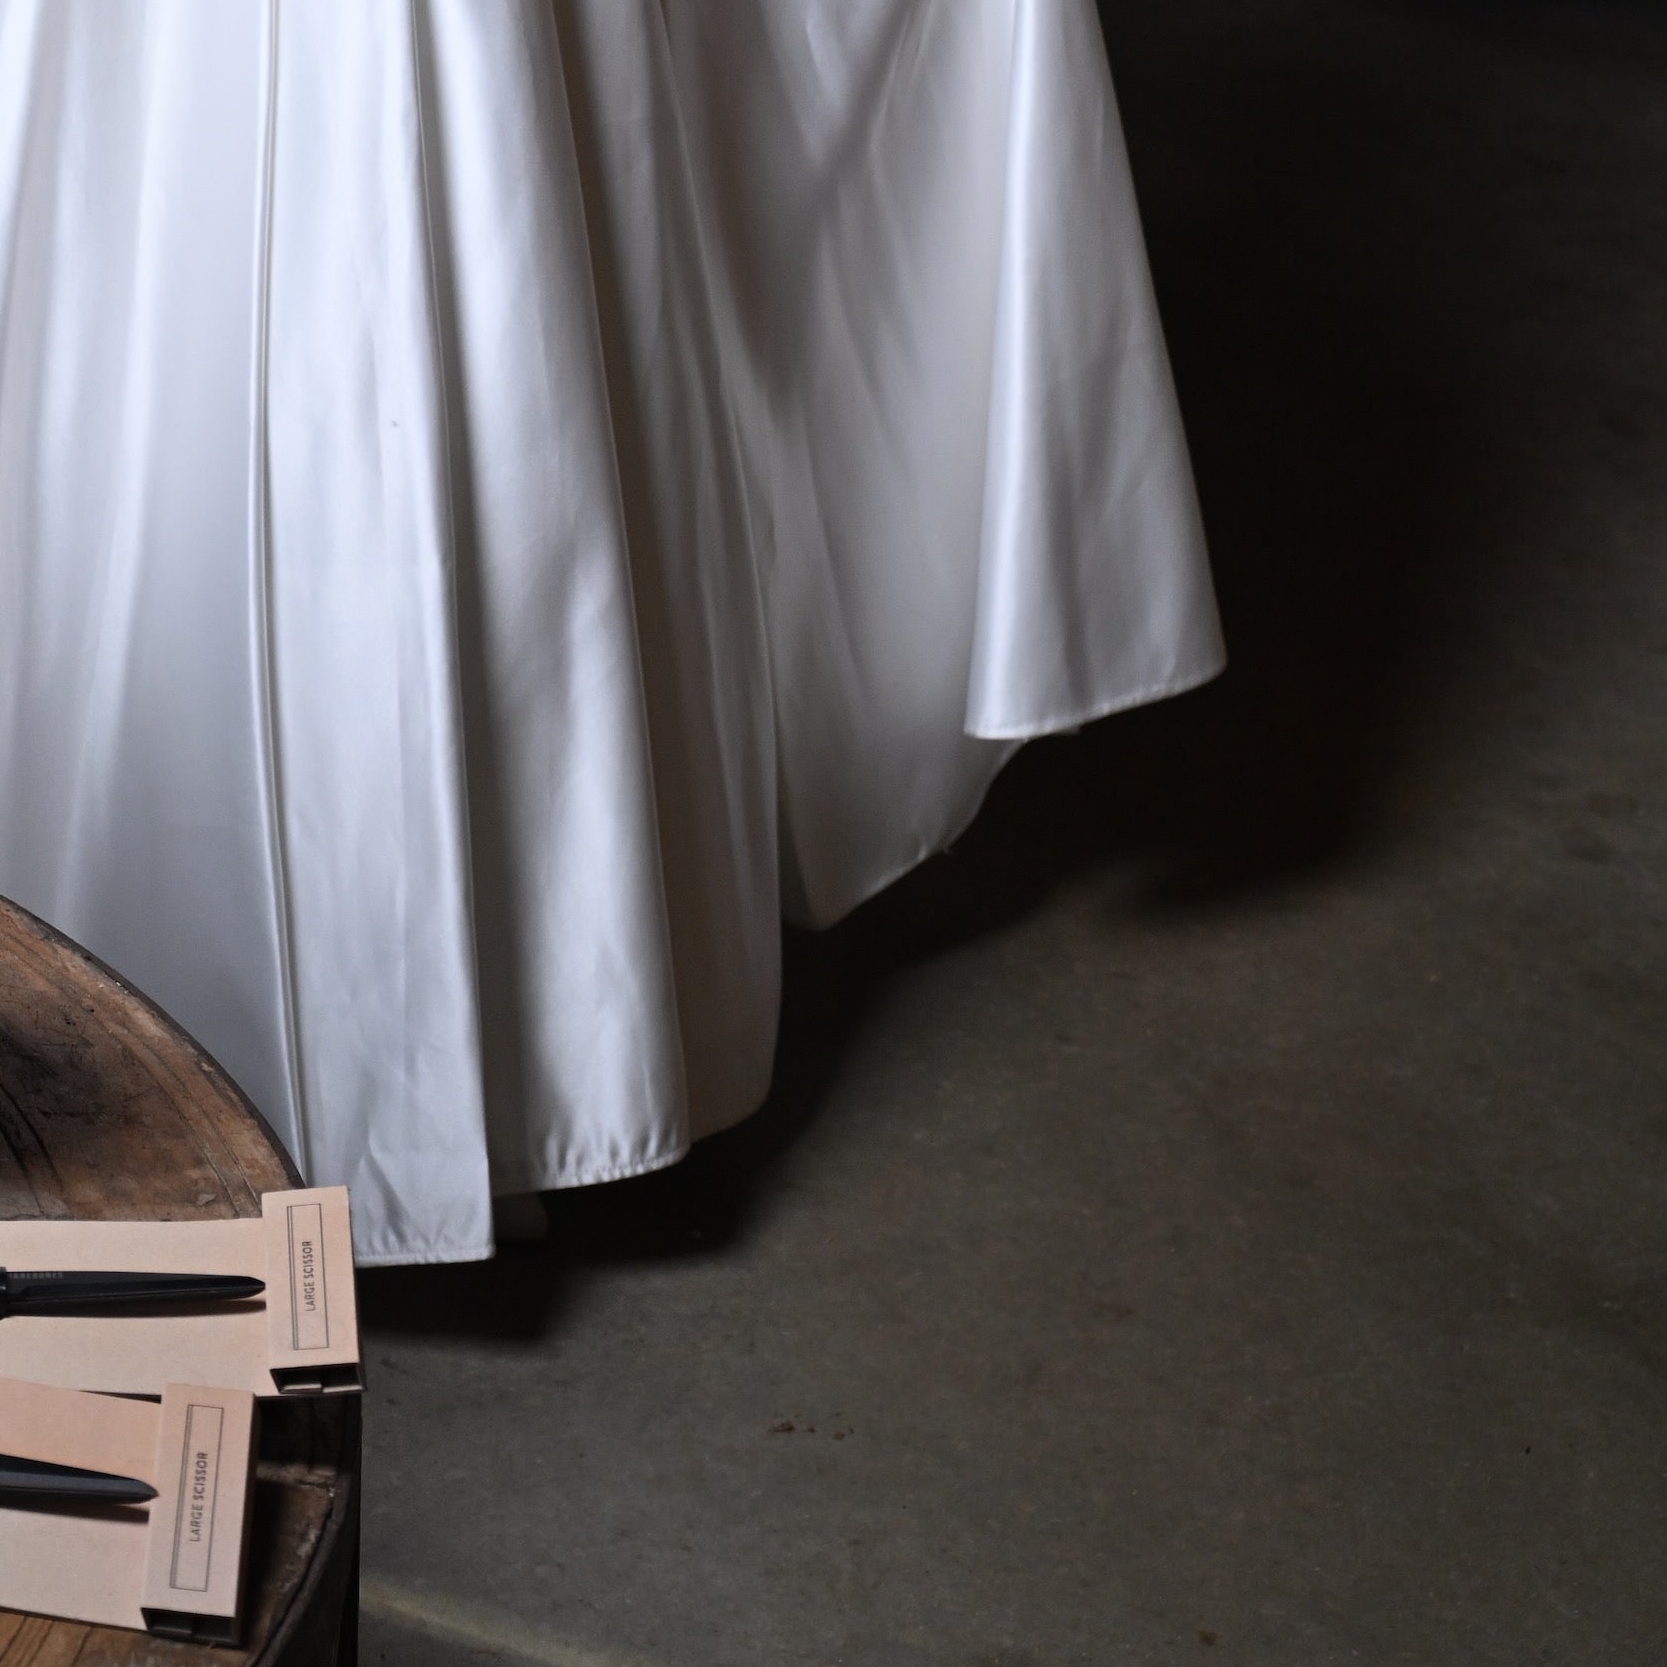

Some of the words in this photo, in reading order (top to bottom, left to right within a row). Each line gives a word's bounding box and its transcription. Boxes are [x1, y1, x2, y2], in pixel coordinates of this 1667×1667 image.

[301, 1240, 314, 1279] SCISSOR
[303, 1281, 316, 1312] LARGE
[192, 1451, 209, 1501] SCISSOR
[189, 1504, 203, 1542] LARGE
